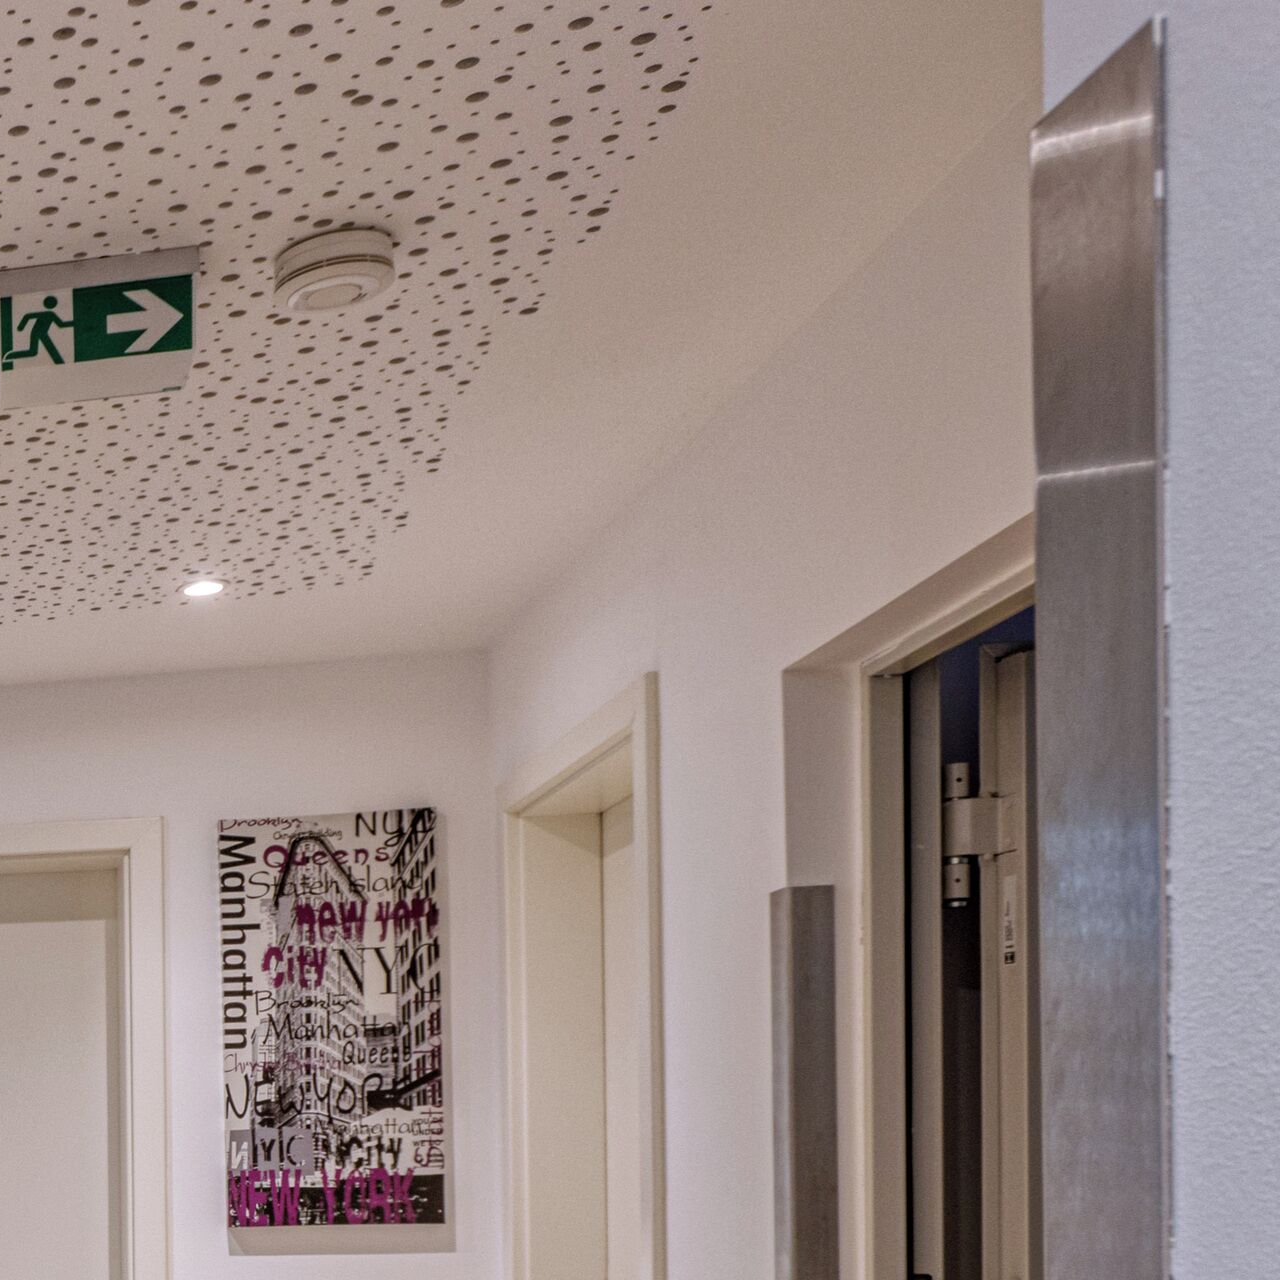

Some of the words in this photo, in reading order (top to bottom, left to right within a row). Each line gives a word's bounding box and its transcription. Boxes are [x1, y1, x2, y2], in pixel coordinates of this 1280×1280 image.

[263, 844, 391, 873] Queens
[218, 834, 261, 1051] Manhattan
[295, 900, 367, 944] new
[262, 944, 328, 988] city
[333, 943, 440, 995] NYC
[253, 990, 360, 1015] Brooklyn
[262, 1011, 412, 1044] Manhattan
[342, 1040, 412, 1064] Queens
[229, 1167, 303, 1227] NEW
[321, 1167, 416, 1225] YORK
